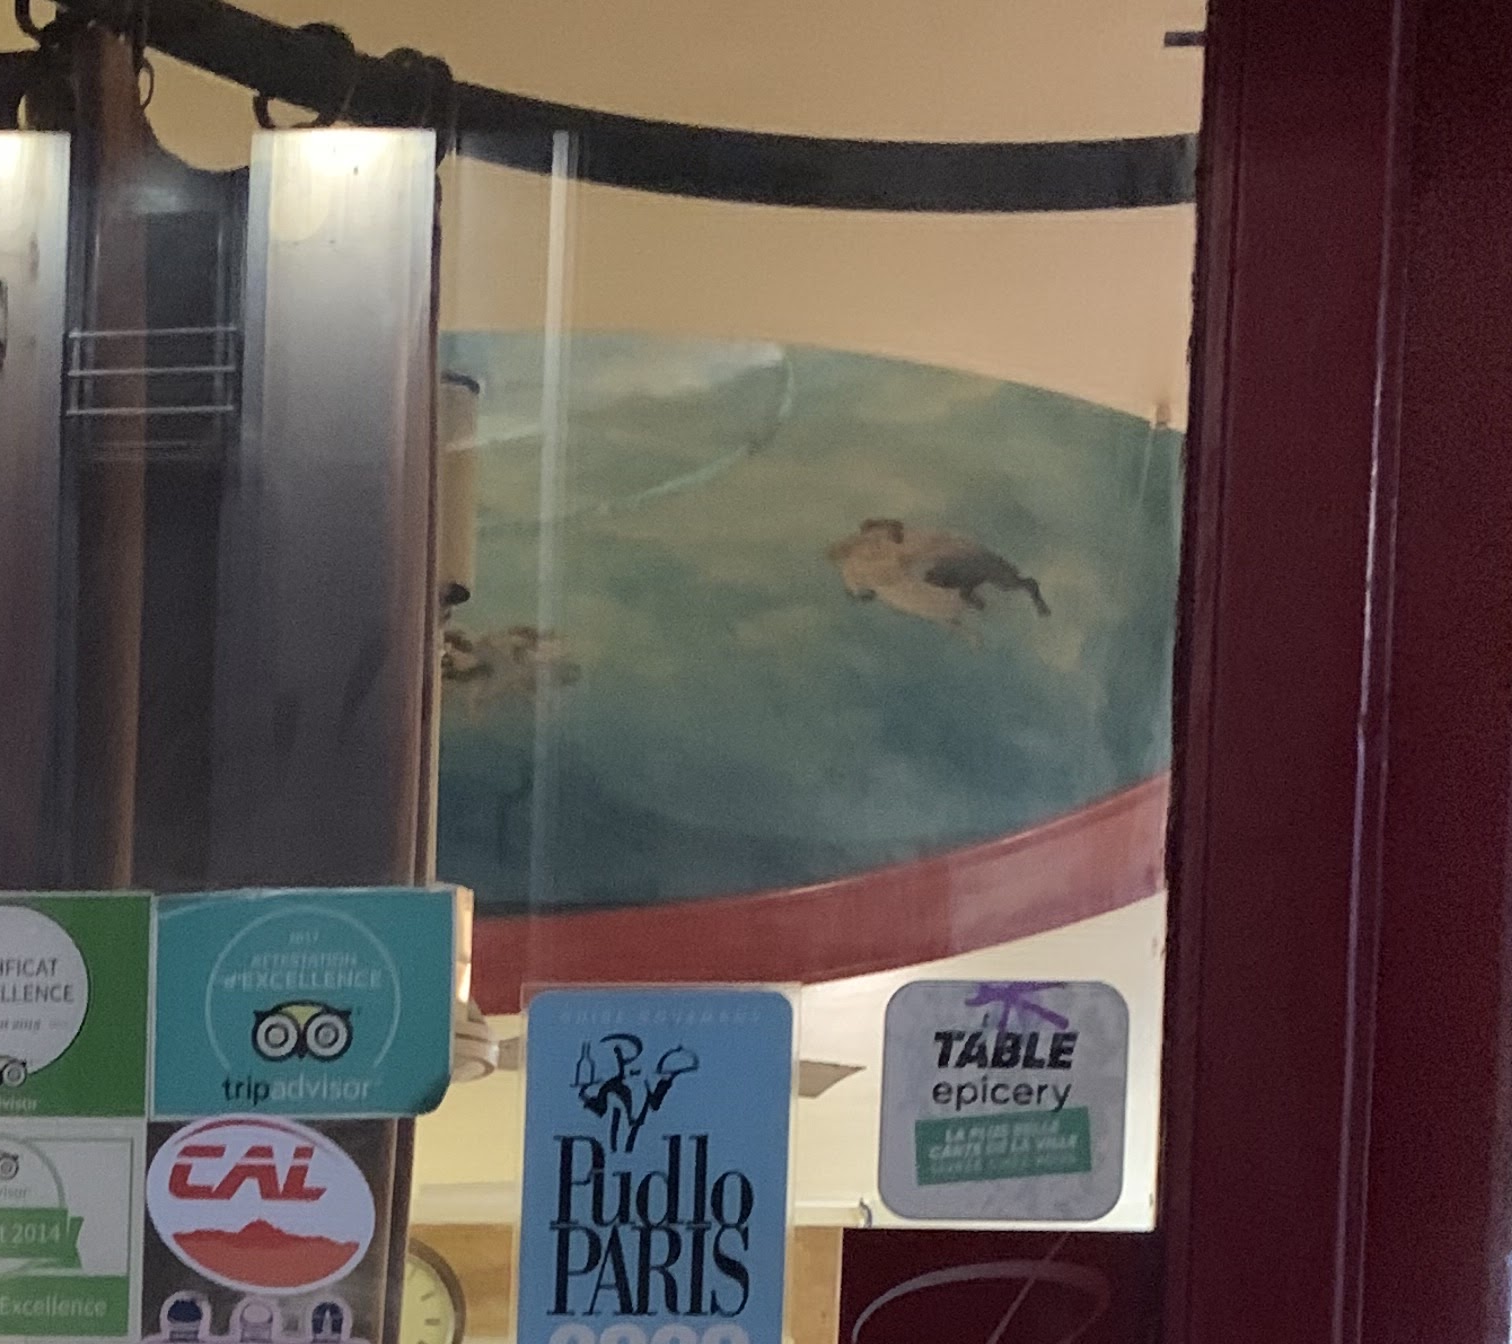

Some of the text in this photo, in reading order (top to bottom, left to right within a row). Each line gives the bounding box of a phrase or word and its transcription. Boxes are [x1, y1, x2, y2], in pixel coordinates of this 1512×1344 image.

[223, 1073, 370, 1105] tripadvisor
[932, 1075, 1072, 1113] epicery
[167, 1144, 329, 1201] CAL
[551, 1133, 754, 1229] Pudlo
[12, 1224, 61, 1244] 2014
[546, 1224, 750, 1319] PARIS
